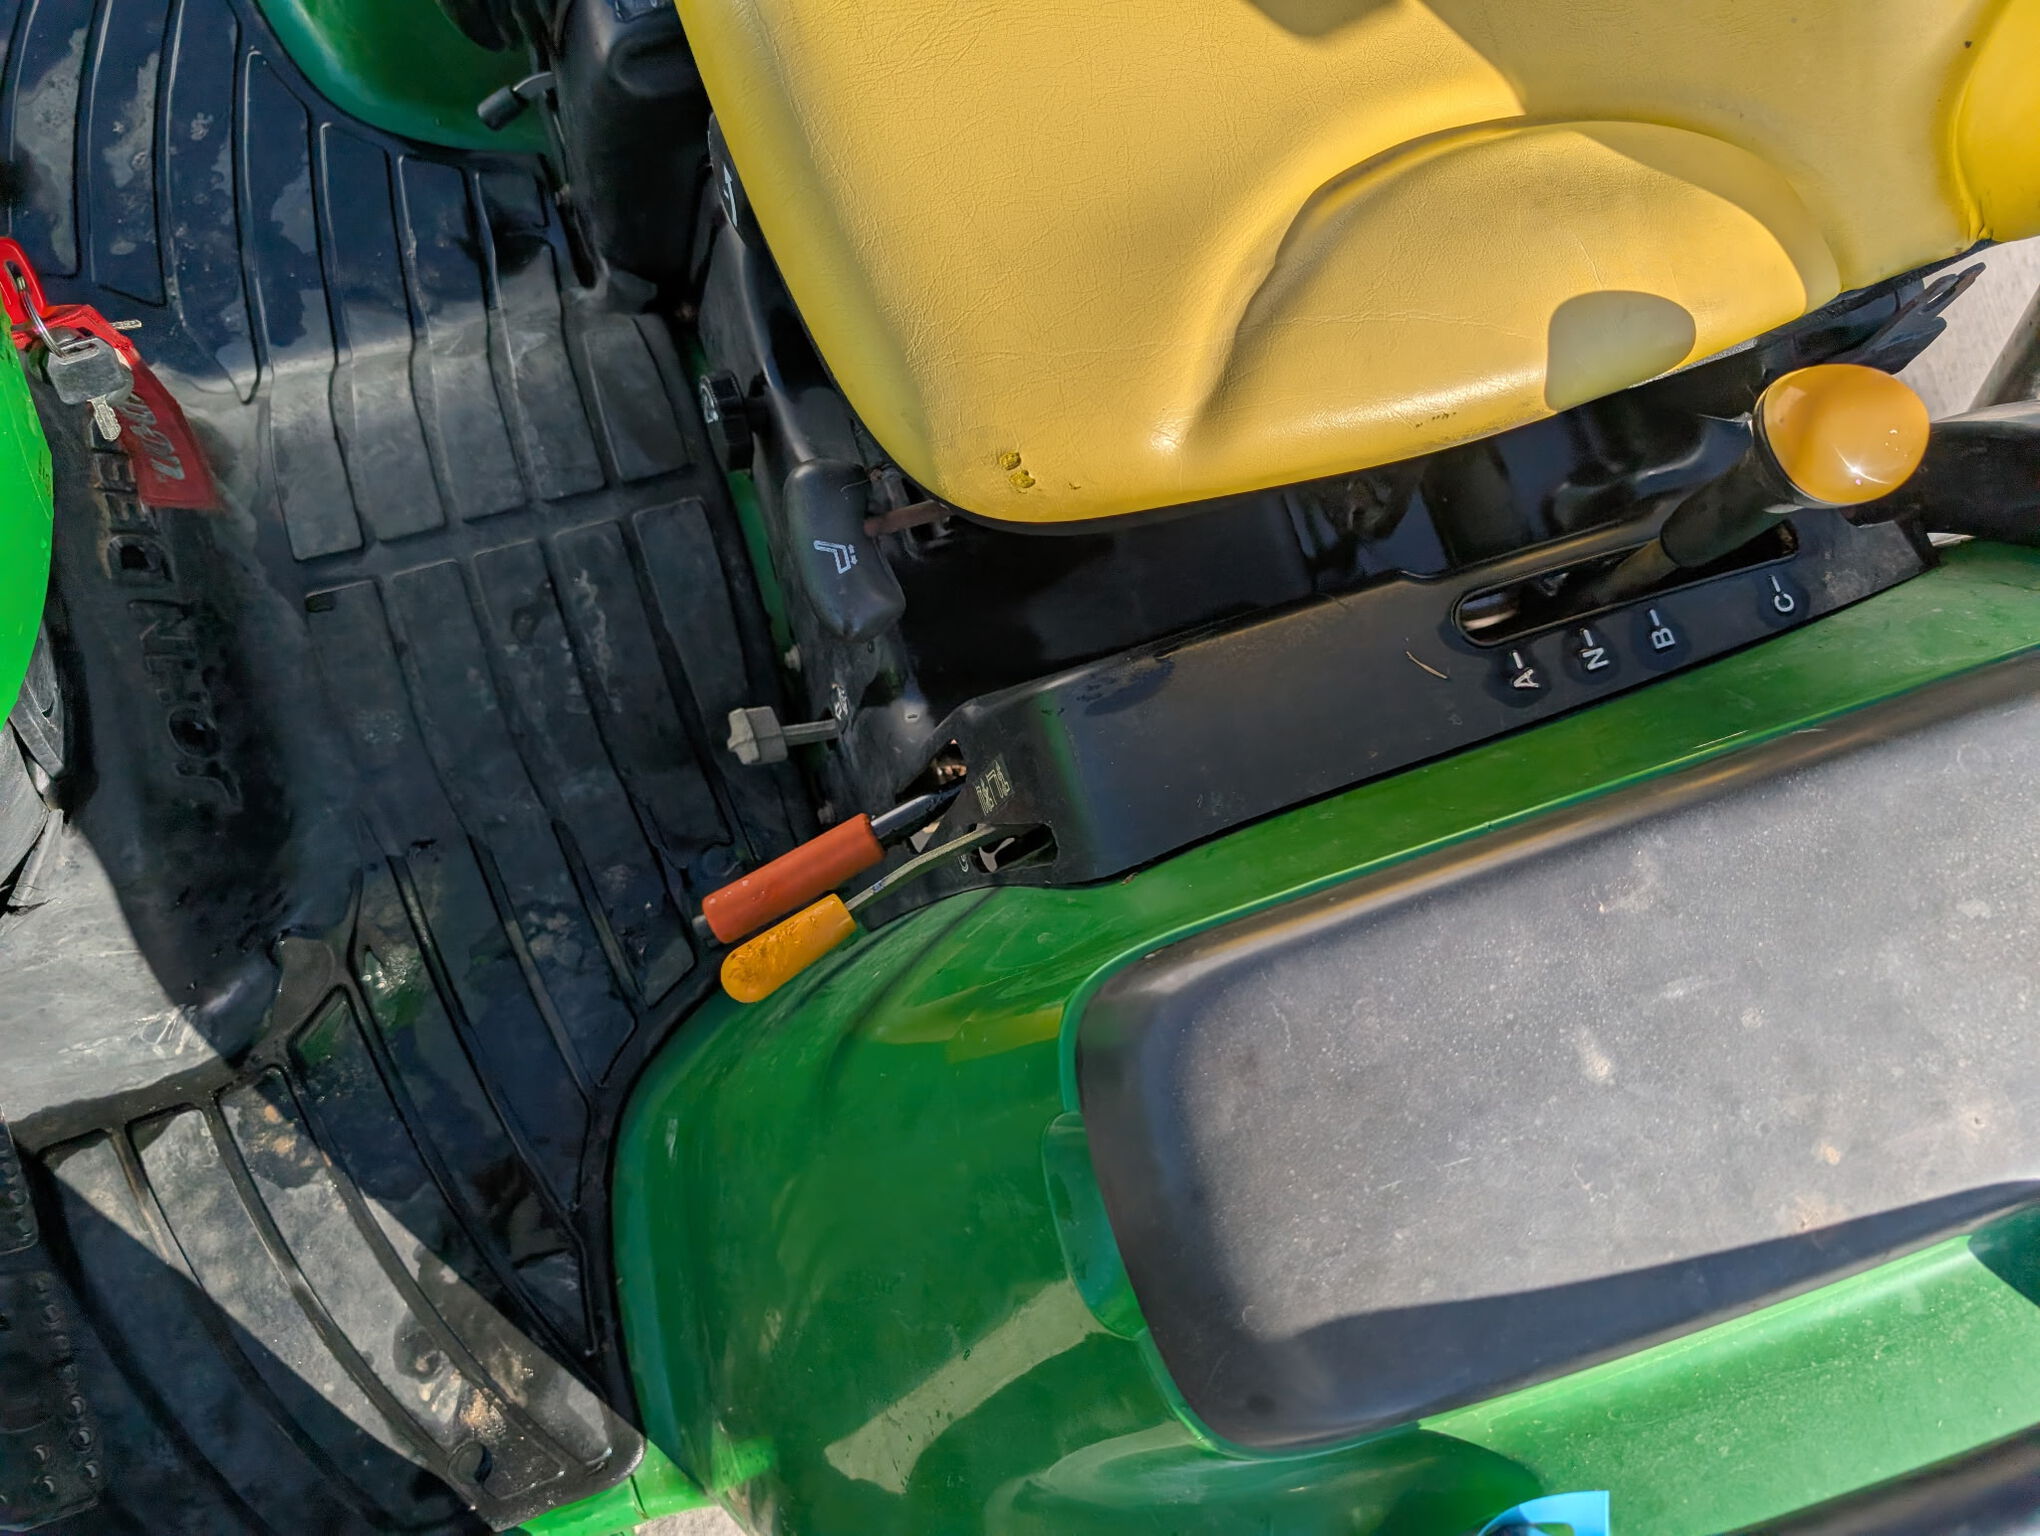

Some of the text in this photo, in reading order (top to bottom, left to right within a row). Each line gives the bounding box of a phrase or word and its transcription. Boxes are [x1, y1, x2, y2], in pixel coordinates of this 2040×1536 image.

[1774, 593, 1794, 613] C
[1651, 627, 1676, 649] B
[1582, 647, 1610, 671] N
[1513, 668, 1540, 688] A
